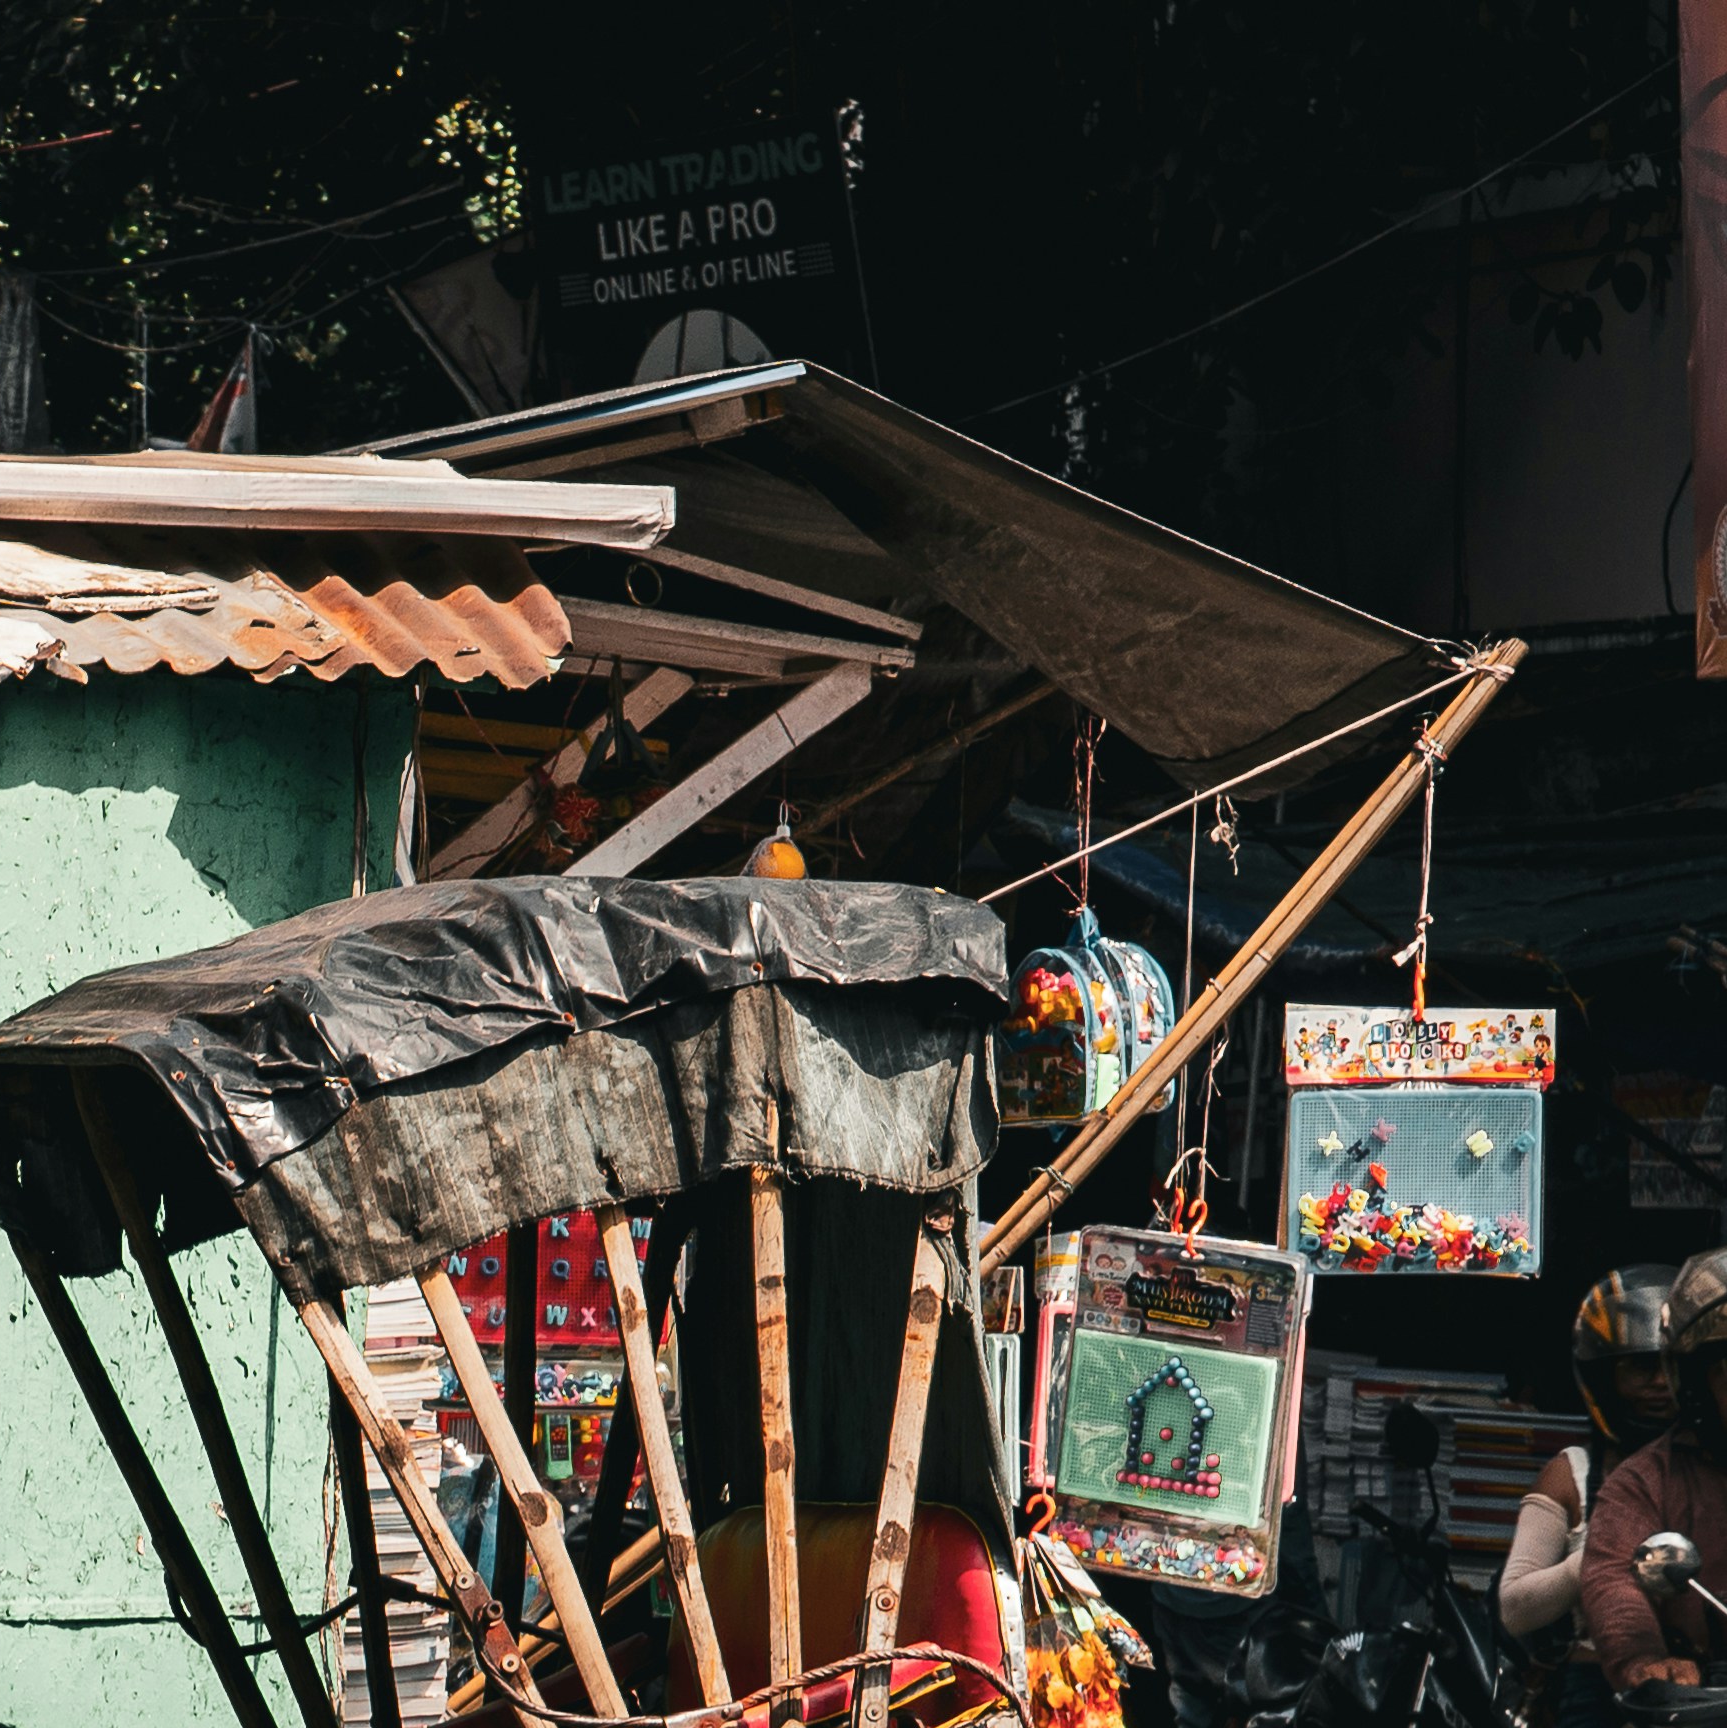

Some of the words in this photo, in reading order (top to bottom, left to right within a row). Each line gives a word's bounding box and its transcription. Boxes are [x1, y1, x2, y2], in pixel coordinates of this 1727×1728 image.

[546, 158, 655, 213] LEARN
[660, 131, 824, 195] TRADING
[597, 214, 669, 261] LIKE
[678, 210, 702, 248] A
[707, 198, 778, 245] PRO
[592, 267, 678, 304] ONLINE
[682, 265, 698, 291] &
[1370, 1020, 1456, 1043] LOELY
[1367, 1041, 1471, 1060] BLOCKS
[551, 1216, 570, 1238] K
[447, 1254, 468, 1277] N
[545, 1305, 568, 1326] W
